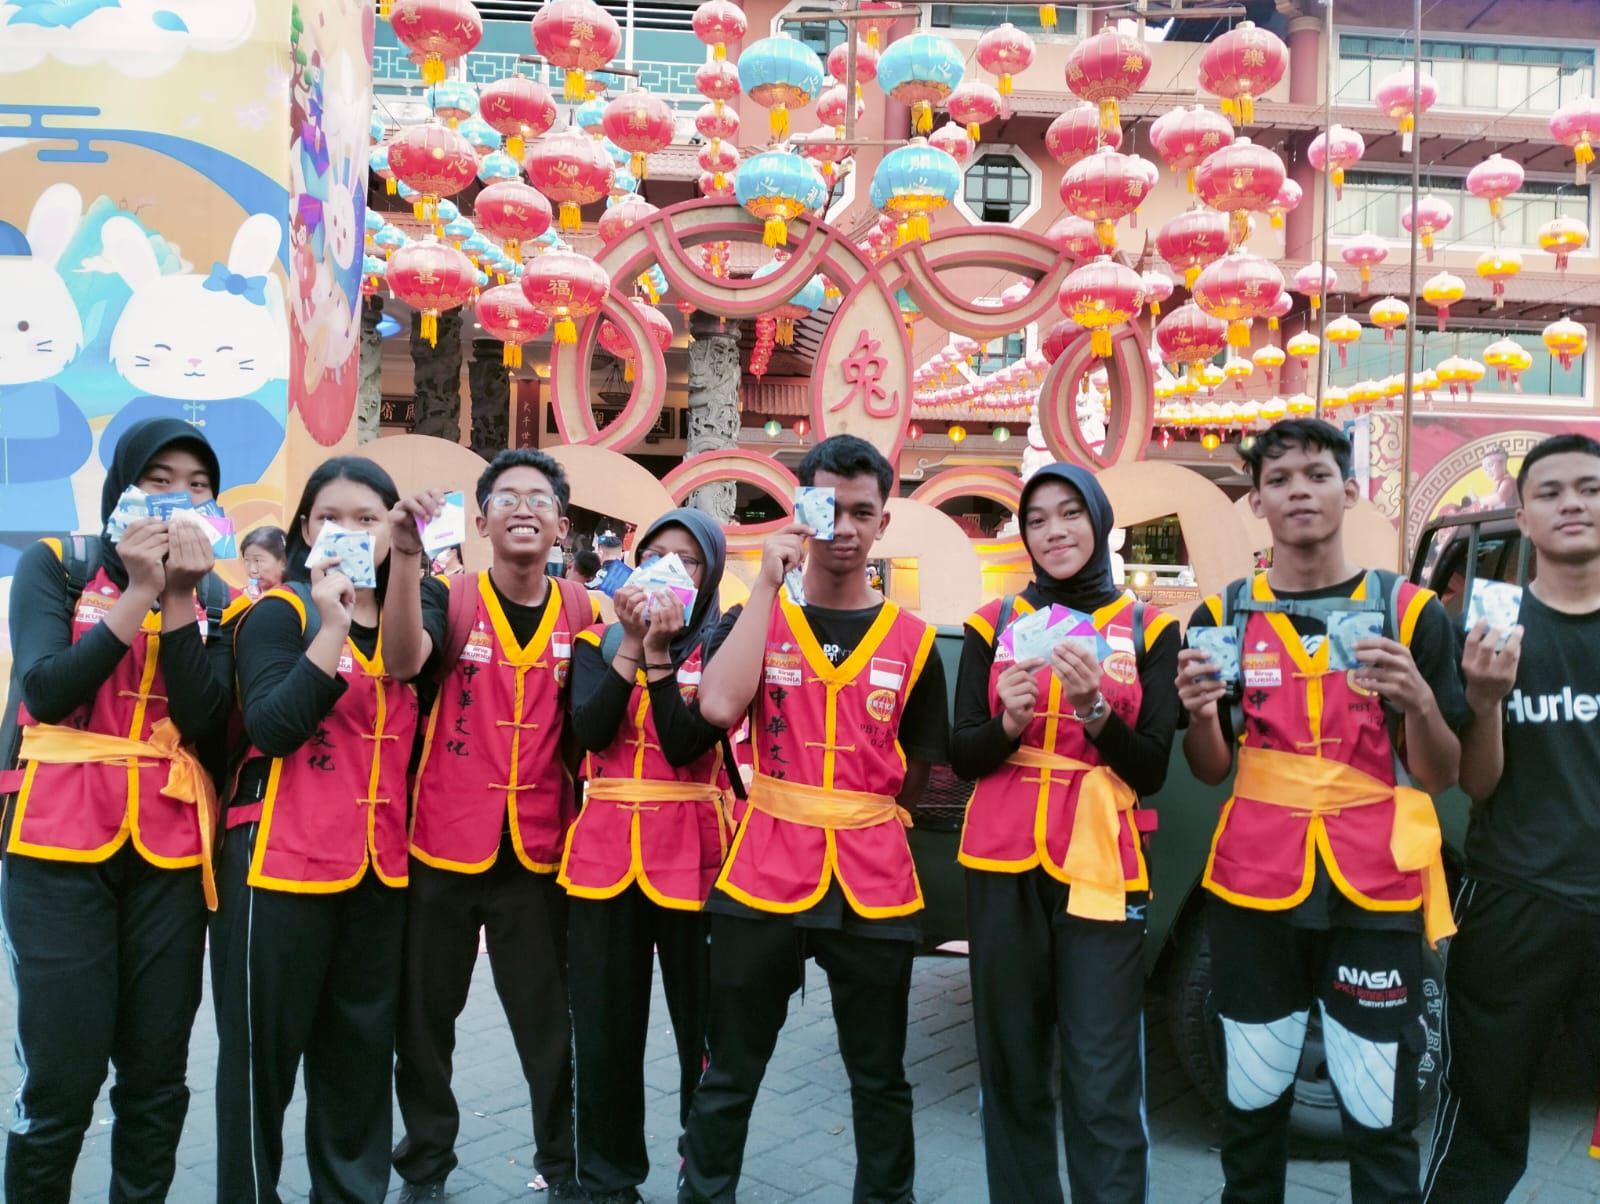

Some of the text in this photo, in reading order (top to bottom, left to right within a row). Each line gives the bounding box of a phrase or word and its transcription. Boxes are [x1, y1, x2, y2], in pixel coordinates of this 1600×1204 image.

[547, 278, 572, 297] 福
[830, 328, 900, 420] 兔
[1506, 686, 1600, 723] Hurle
[1337, 965, 1402, 990] NASA
